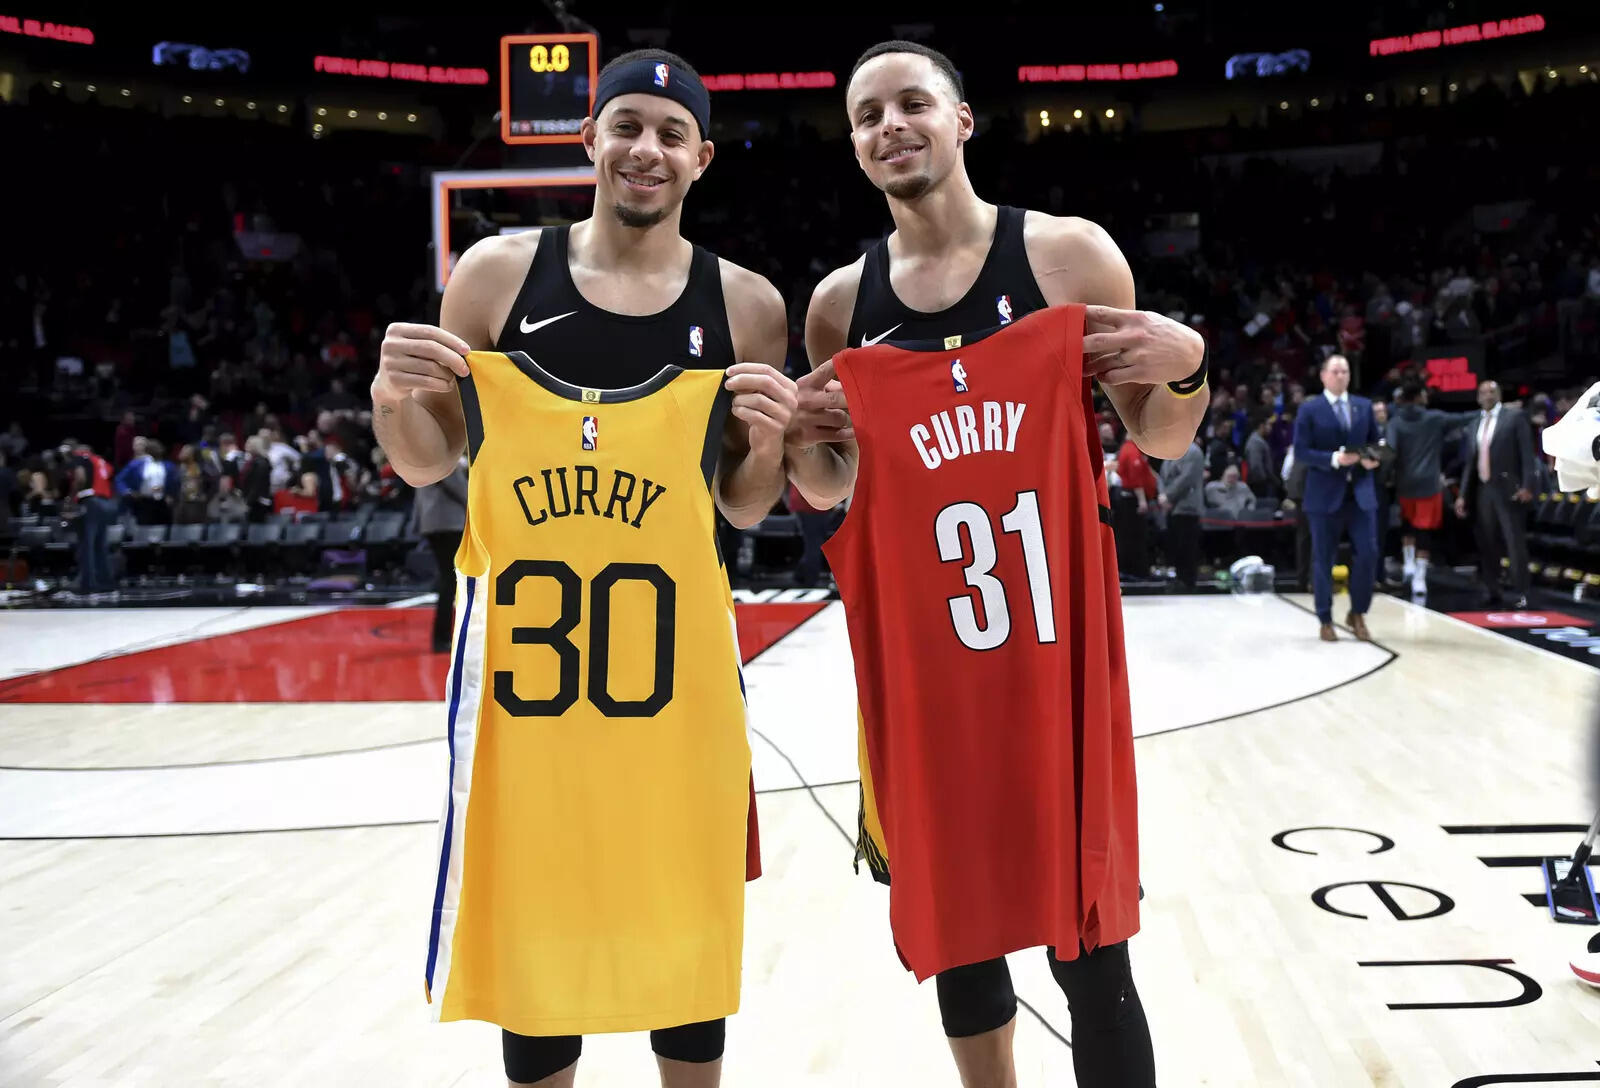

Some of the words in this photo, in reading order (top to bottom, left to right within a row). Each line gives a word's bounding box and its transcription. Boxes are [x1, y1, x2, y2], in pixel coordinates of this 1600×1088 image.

[529, 44, 570, 73] 0.0
[909, 400, 1026, 471] CURRY
[512, 465, 667, 530] CURRY
[934, 489, 1057, 651] 31
[493, 559, 677, 718] 30
